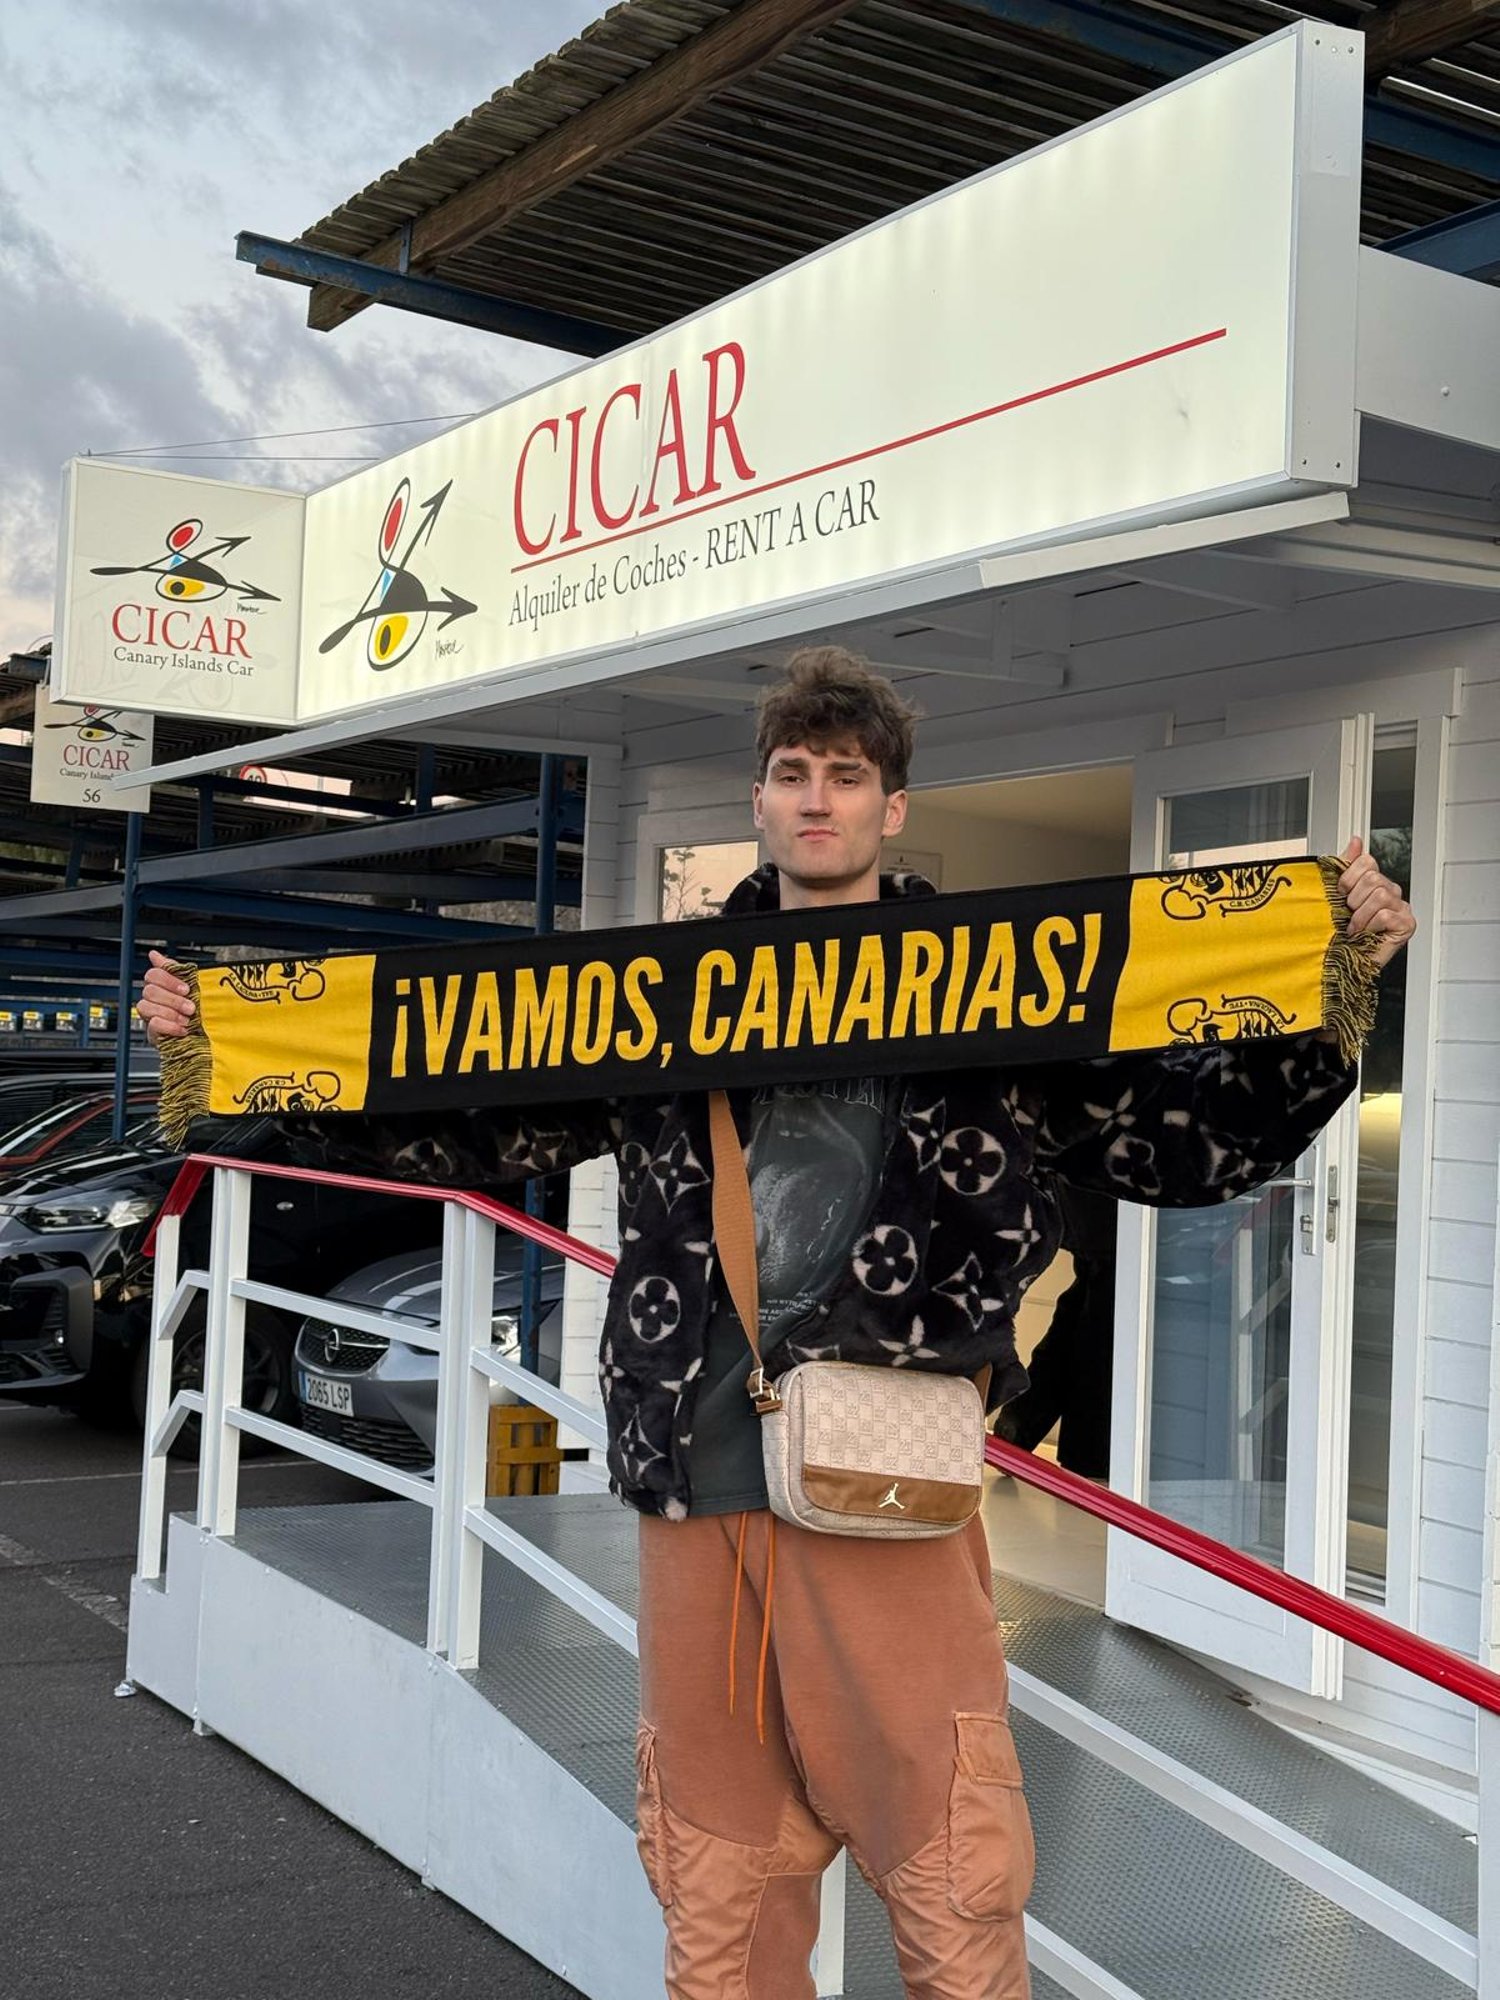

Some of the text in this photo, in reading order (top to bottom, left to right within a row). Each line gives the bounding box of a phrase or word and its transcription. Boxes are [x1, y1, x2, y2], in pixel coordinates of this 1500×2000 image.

[513, 341, 757, 556] CICAR
[508, 573, 581, 632] Alquiler
[584, 562, 608, 603] de
[612, 542, 687, 596] Coches
[705, 506, 782, 570] RENT
[785, 501, 808, 547] A
[814, 479, 881, 537] CAR
[111, 603, 253, 660] CICAR
[113, 646, 255, 677] Canary Islands Car
[63, 744, 131, 771] CICAR
[59, 767, 88, 781] Canary
[82, 788, 101, 803] 56
[1244, 878, 1276, 906] CANARIAS
[391, 912, 1103, 1079] ¡VAMOS, CANARIAS!
[330, 1384, 350, 1411] LSP
